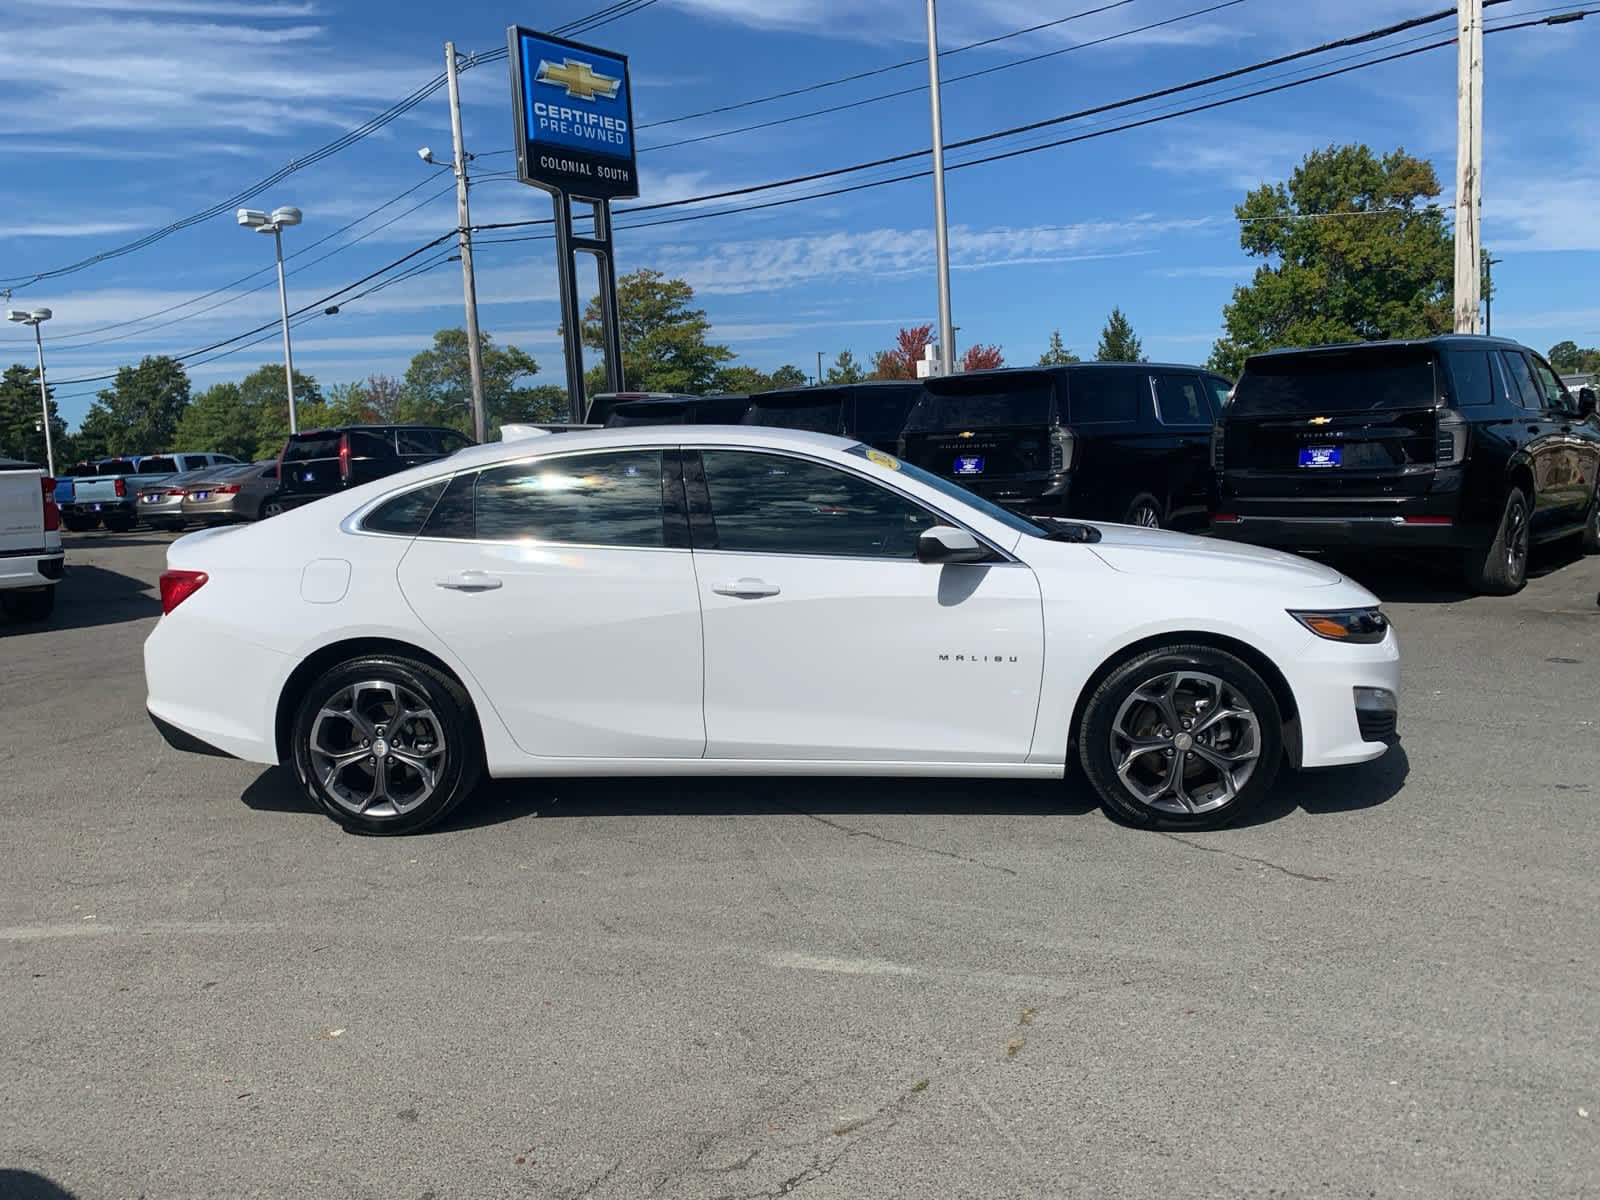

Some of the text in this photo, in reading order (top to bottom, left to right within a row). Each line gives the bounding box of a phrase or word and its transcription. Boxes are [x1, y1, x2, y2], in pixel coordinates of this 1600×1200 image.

[534, 102, 627, 132] CERTIFIED
[540, 118, 624, 144] PRE-OWNED
[540, 156, 629, 181] COLONIAL SOUTH
[938, 654, 1018, 663] MALIBU
